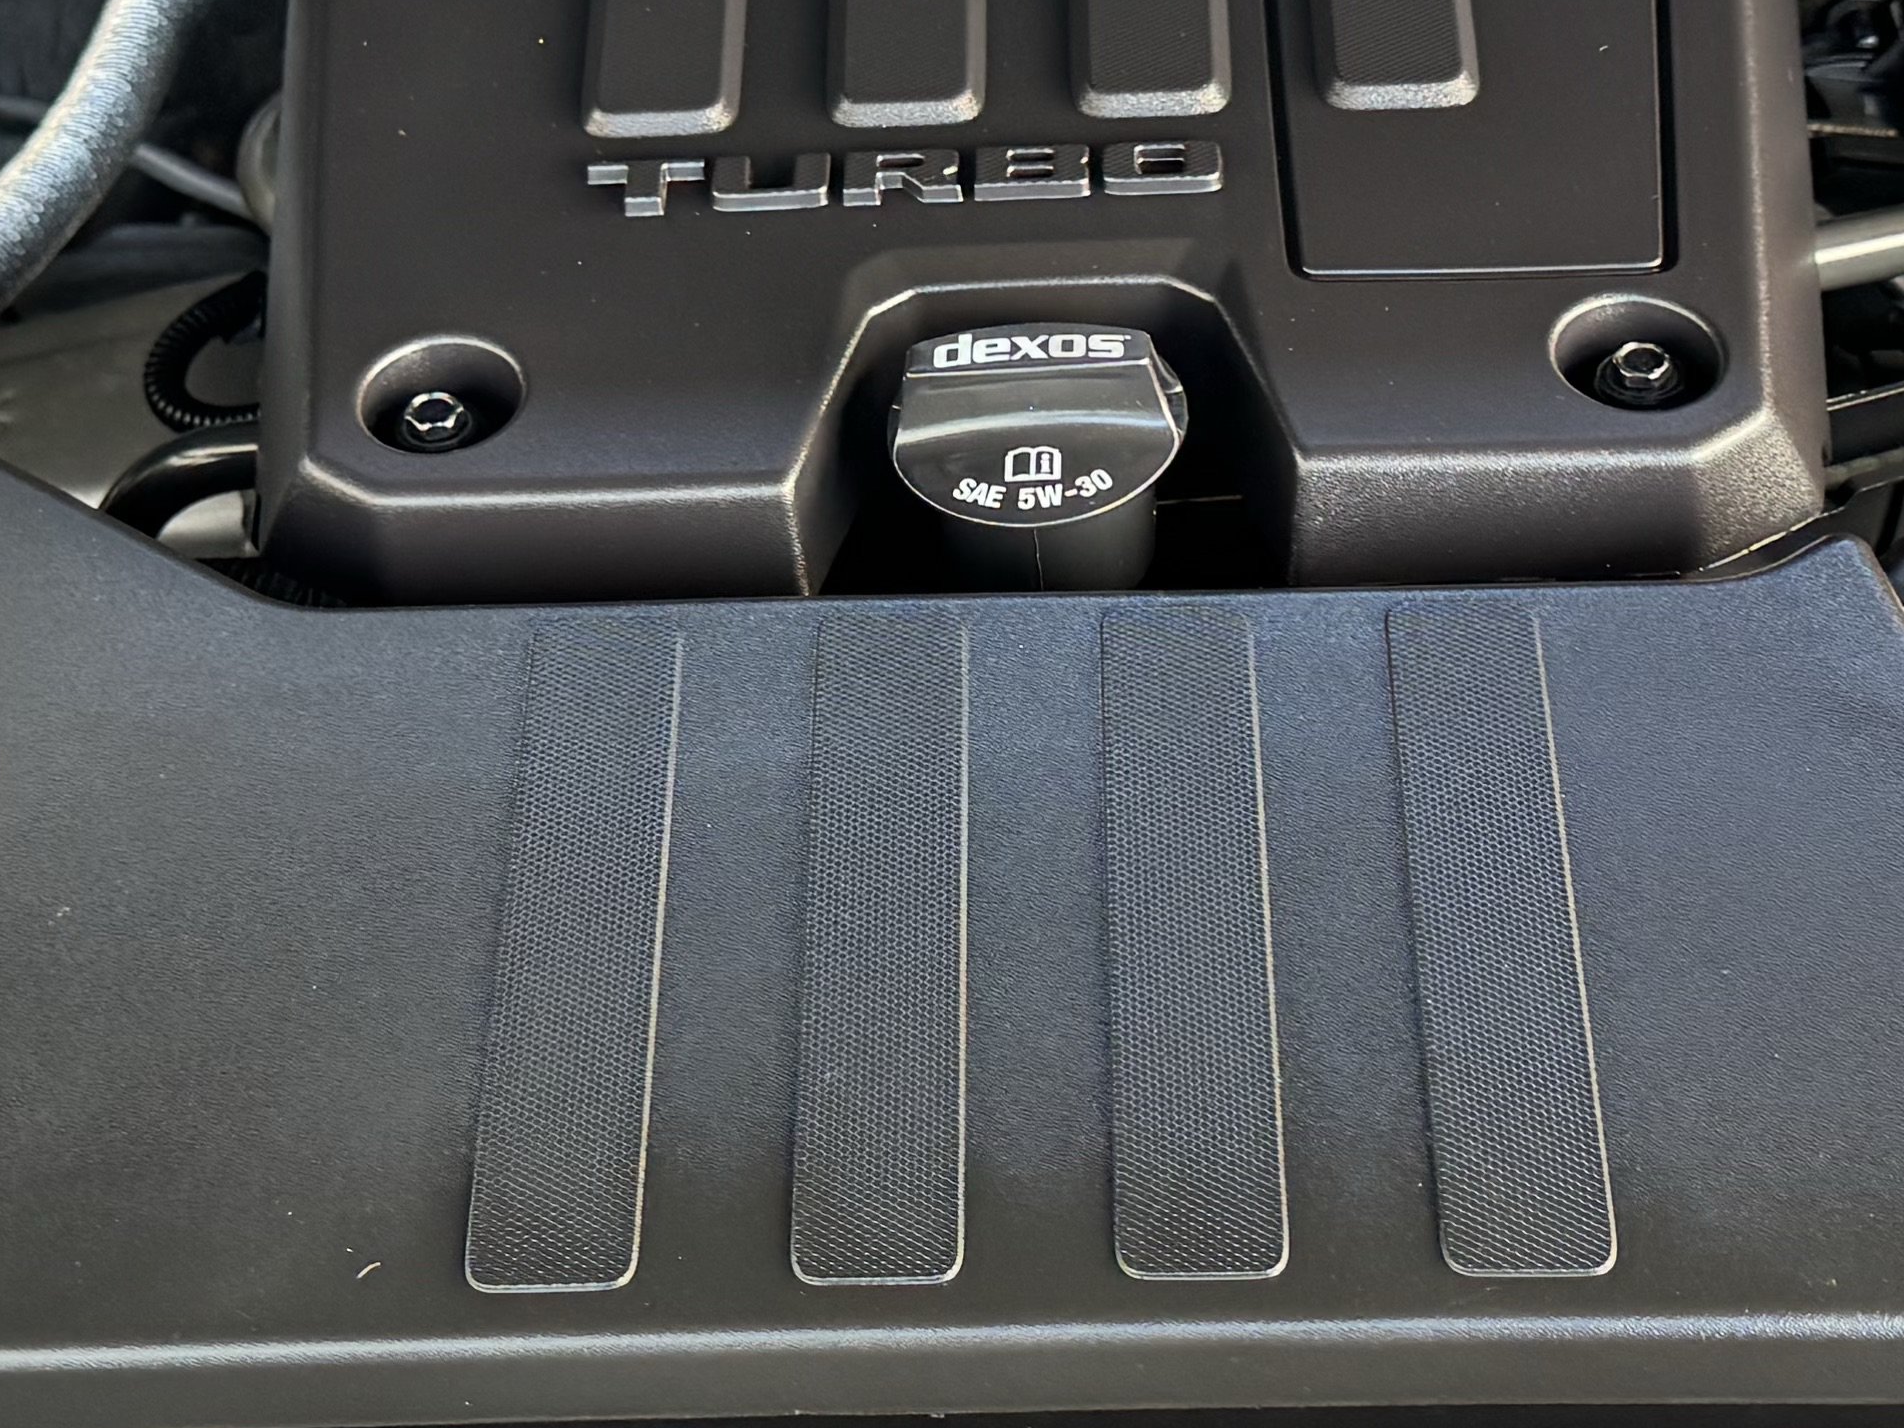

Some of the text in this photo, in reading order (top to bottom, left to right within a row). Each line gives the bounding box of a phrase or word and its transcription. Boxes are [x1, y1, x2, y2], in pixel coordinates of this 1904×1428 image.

[585, 139, 1226, 218] TURBO
[931, 332, 1127, 370] dexos
[951, 468, 1115, 513] SAE 5W-30
